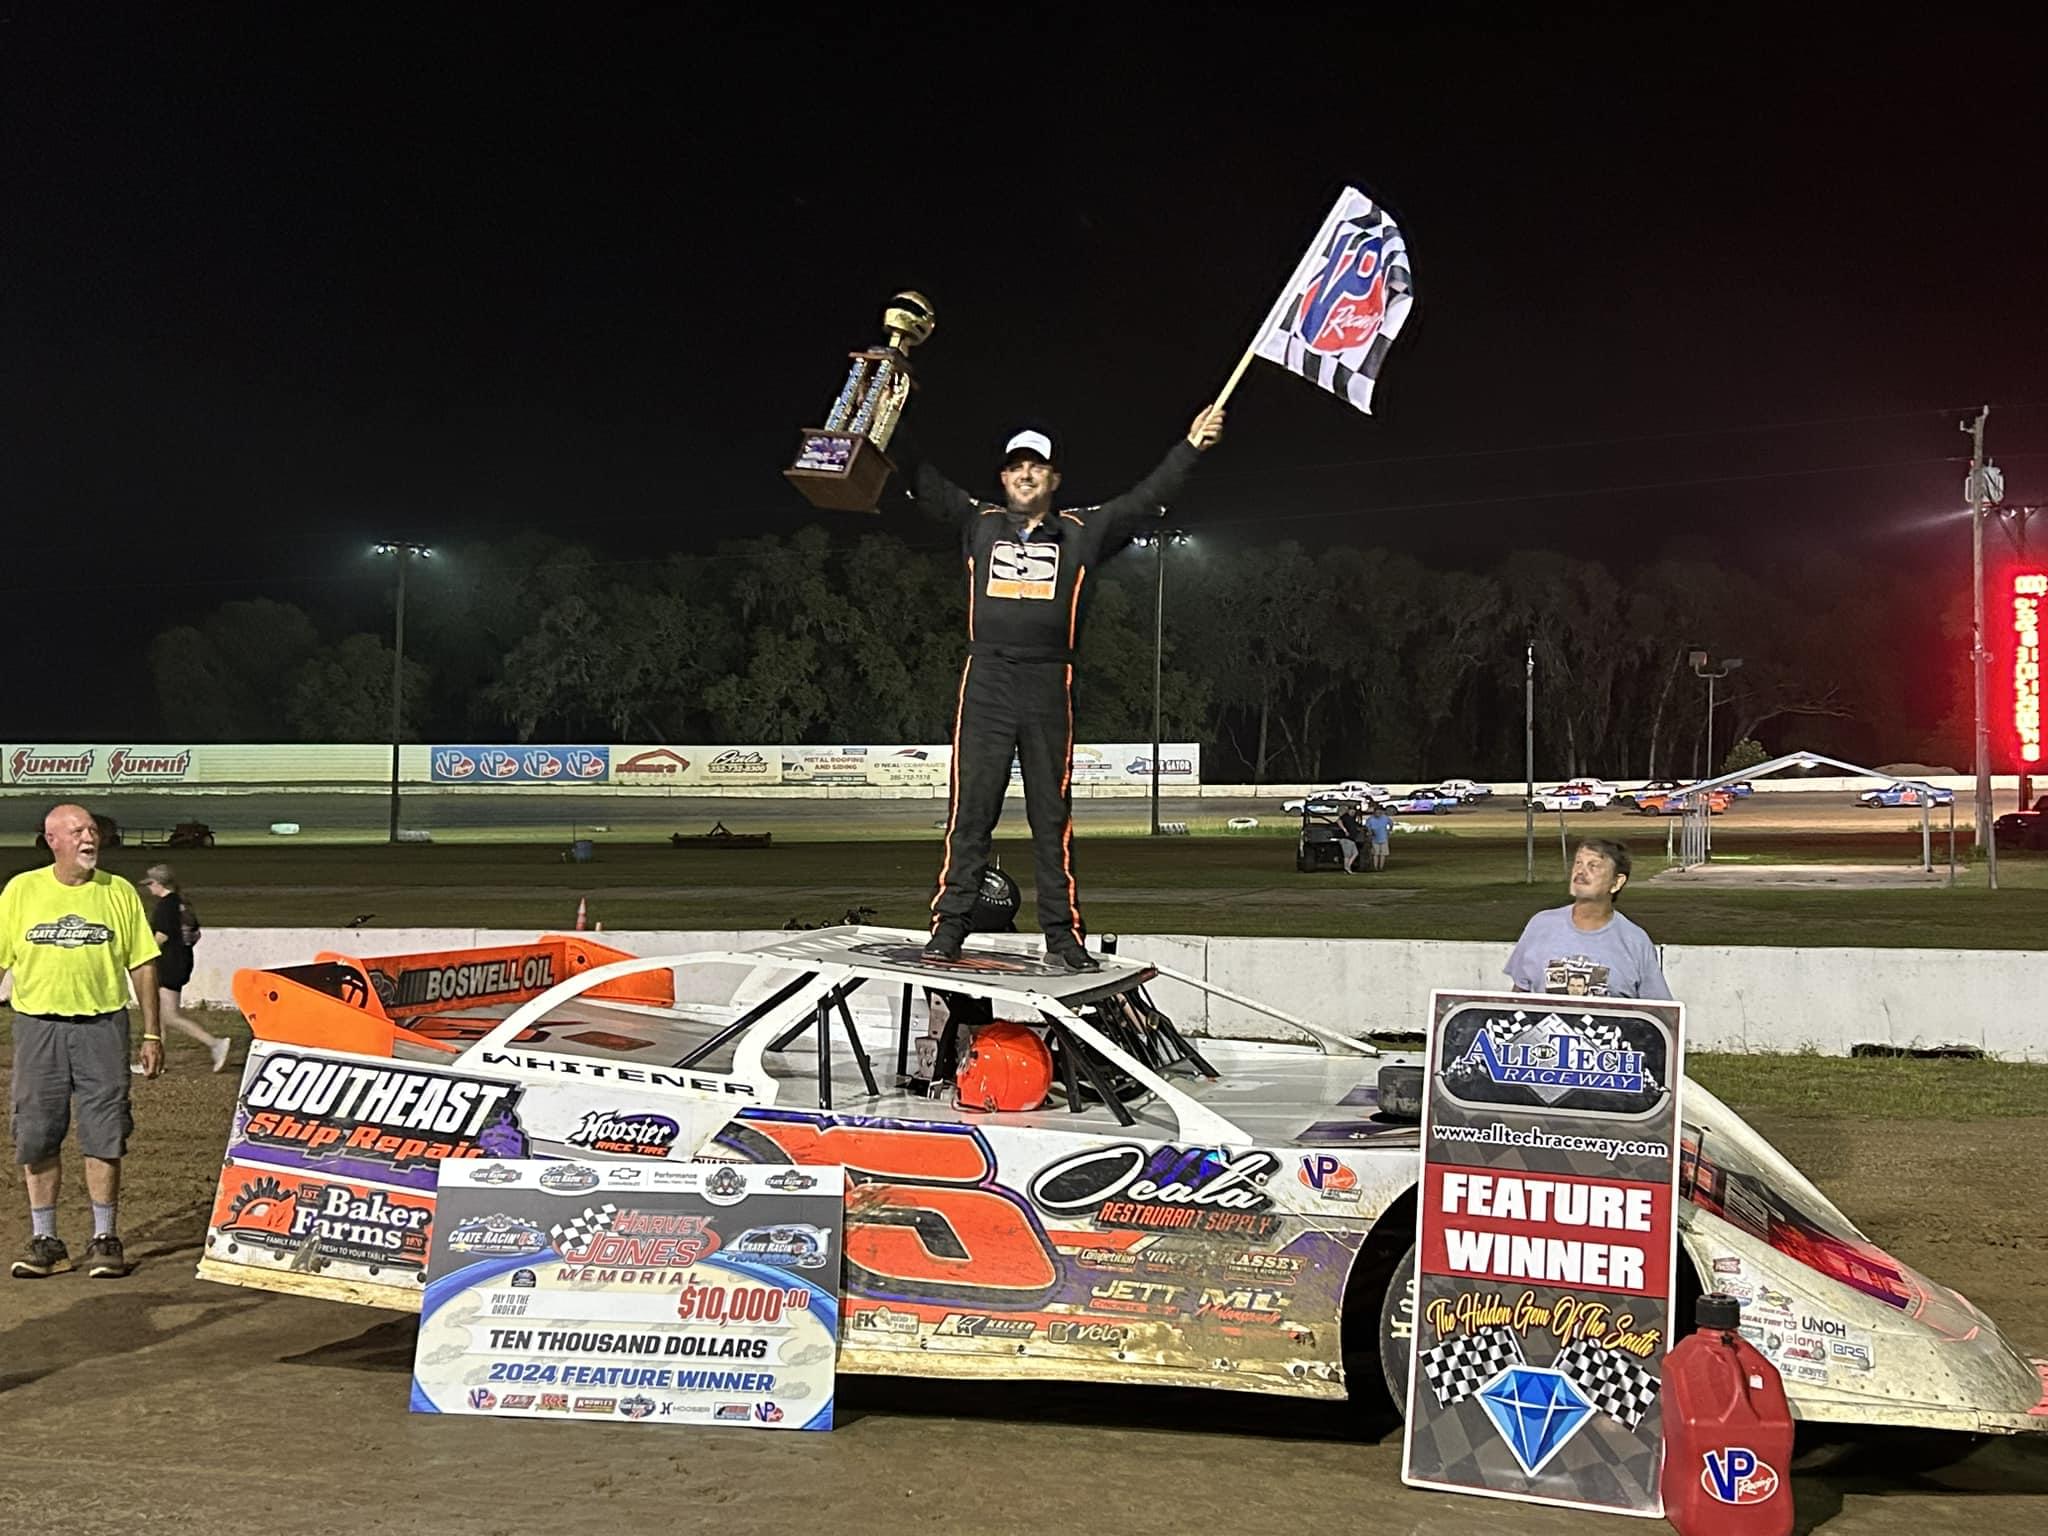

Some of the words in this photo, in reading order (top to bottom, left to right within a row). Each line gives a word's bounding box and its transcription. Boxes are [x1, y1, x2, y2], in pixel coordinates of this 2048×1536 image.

[437, 751, 462, 776] VP
[481, 751, 506, 776] VP
[525, 751, 549, 776] VP
[568, 751, 593, 776] VP
[425, 961, 521, 1001] BOSWELL
[523, 955, 554, 988] OIL
[482, 1051, 755, 1097] WHITENER
[1502, 1068, 1636, 1088] RACEWAY
[248, 1055, 510, 1137] SOUTHEAST
[248, 1112, 341, 1147] Ship
[346, 1125, 483, 1160] Repair
[577, 1109, 672, 1147] Hoosier
[594, 1140, 633, 1153] RACE
[636, 1144, 670, 1157] TIRE
[1433, 1123, 1667, 1160] www.alltechraceway.com
[1031, 1148, 1271, 1209] Ocala
[1302, 1155, 1339, 1190] VP
[322, 1187, 428, 1229] Baker
[1442, 1172, 1652, 1232] FEATURE
[290, 1206, 402, 1250] Farms
[611, 1208, 715, 1234] HARVEY
[1098, 1201, 1204, 1229] RESTAURANT
[1206, 1210, 1271, 1236] SUPPLY
[266, 1235, 289, 1246] FAMILY
[289, 1239, 305, 1248] FAR
[319, 1244, 338, 1254] FRESH
[339, 1246, 348, 1255] TO
[349, 1248, 366, 1259] YOUR
[367, 1250, 386, 1262] TABLE
[447, 1230, 482, 1244] CRATE
[564, 1230, 702, 1267] JONES
[1225, 1253, 1303, 1271] ASSEY
[1444, 1228, 1646, 1290] WINNER
[557, 1268, 702, 1285] MEMORIAL
[491, 1293, 505, 1304] PAY
[506, 1294, 516, 1305] TO
[516, 1294, 531, 1305] THE
[1091, 1279, 1185, 1304] JETT
[491, 1304, 515, 1315] ORDER
[516, 1305, 527, 1316] OF
[678, 1285, 809, 1326] $10,000.00
[857, 1312, 877, 1328] FK
[986, 1319, 1036, 1331] KEIZER
[1426, 1297, 1457, 1342] The
[1456, 1292, 1513, 1337] Hidden
[1513, 1290, 1551, 1339] Gem
[1551, 1295, 1580, 1348] Of
[1579, 1302, 1612, 1341] The
[1602, 1314, 1662, 1358] South
[1802, 1315, 1846, 1337] UNOH
[490, 1329, 533, 1350] TEN
[537, 1331, 661, 1355] THOUSAND
[664, 1336, 769, 1359] DOLLARS
[1833, 1343, 1866, 1359] BRS
[488, 1362, 557, 1383] 2024
[560, 1365, 672, 1388] FEATURE
[677, 1369, 776, 1392] WINNER
[469, 1387, 488, 1409] VP
[756, 1401, 775, 1422] VP
[1702, 1447, 1757, 1503] VP
[1737, 1476, 1778, 1496] Racing
